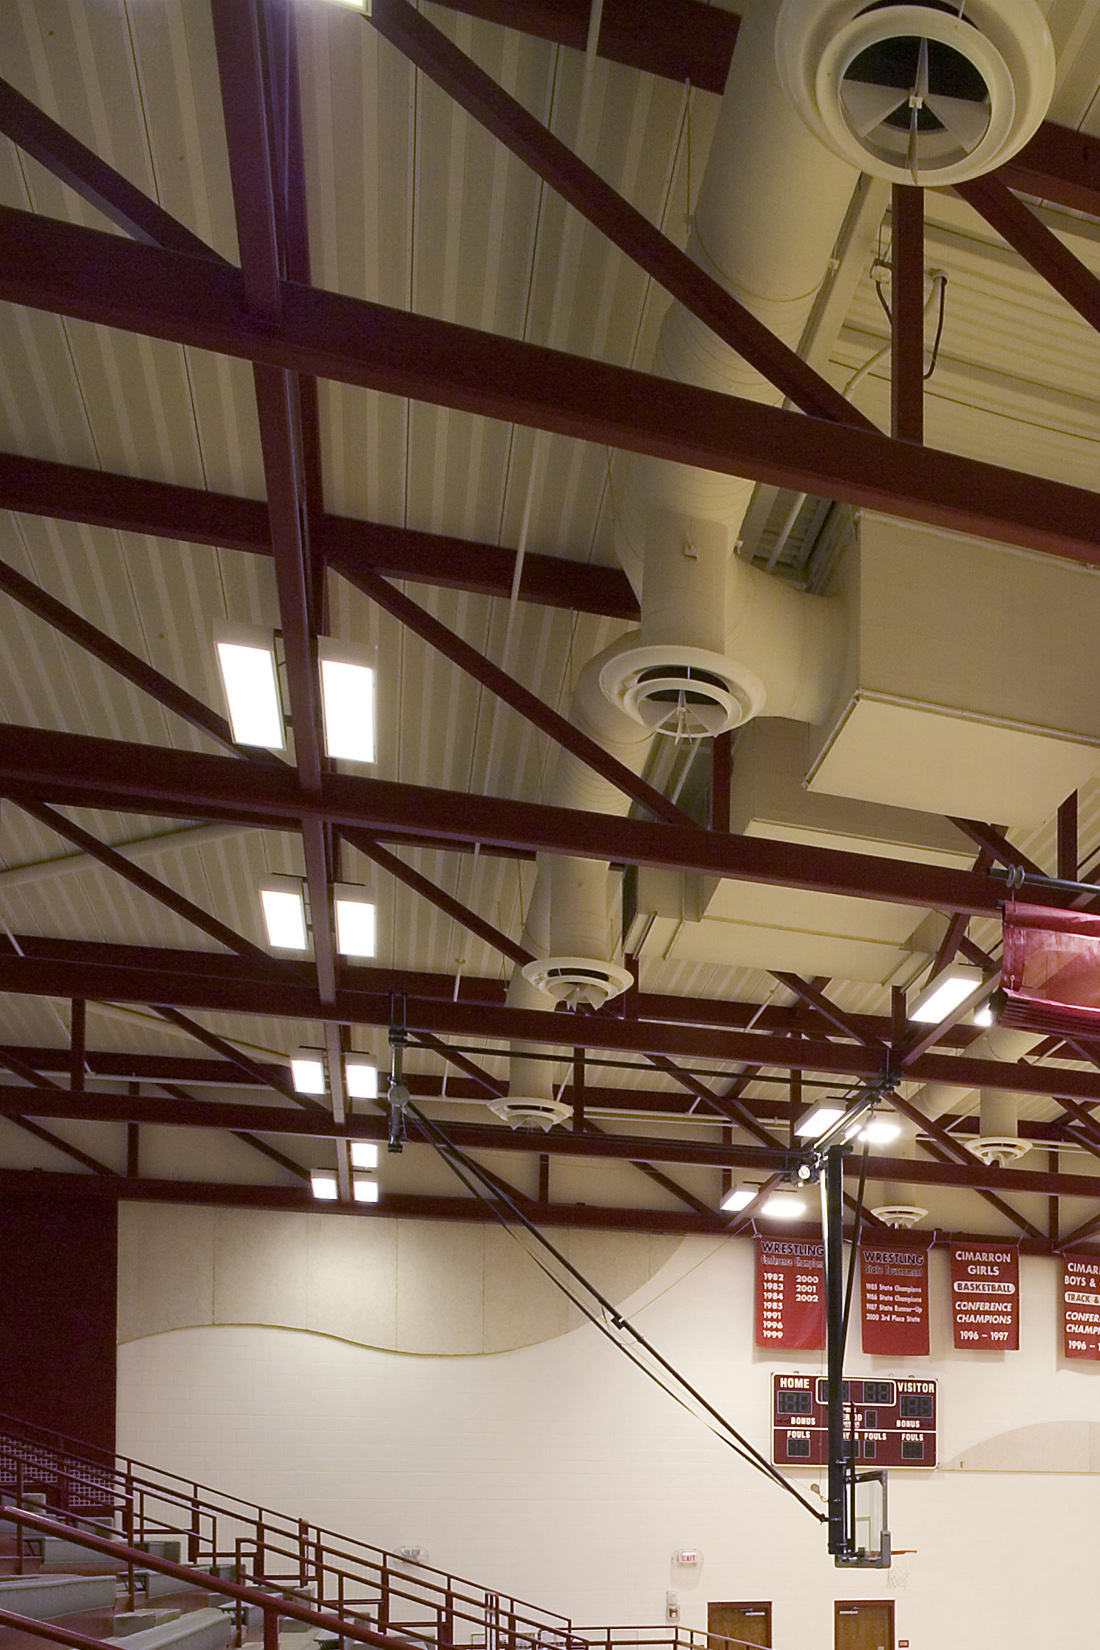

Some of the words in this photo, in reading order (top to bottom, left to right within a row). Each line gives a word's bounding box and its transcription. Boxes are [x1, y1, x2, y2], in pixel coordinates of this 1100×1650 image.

[761, 1241, 825, 1257] WRESTLING
[863, 1250, 924, 1266] WRESTLING
[955, 1251, 1011, 1263] CIMARRON
[967, 1265, 1000, 1276] GIRLS
[763, 1273, 784, 1281] 1982
[795, 1275, 819, 1283] 2000
[1064, 1275, 1086, 1286] BOYS
[1089, 1278, 1096, 1288] &
[763, 1282, 784, 1291] 1983
[795, 1284, 817, 1293] 2001
[957, 1282, 1012, 1293] BASKETBALL
[763, 1292, 784, 1300] 1984
[795, 1294, 819, 1302] 2002
[1067, 1293, 1090, 1303] TRACK
[1093, 1296, 1099, 1304] &
[763, 1301, 783, 1310] 1985
[955, 1301, 1012, 1312] CONFERENCE
[763, 1311, 781, 1319] 1991
[956, 1314, 1012, 1324] CHAMPIONS
[763, 1321, 783, 1329] 1996
[763, 1330, 783, 1339] 1999
[960, 1331, 979, 1340] 1996
[990, 1331, 1009, 1341] 1997
[1068, 1340, 1087, 1350] 1996
[780, 1378, 810, 1389] HOME
[897, 1382, 935, 1393] VISITOR
[791, 1417, 816, 1425] BONUS
[896, 1420, 921, 1428] BONUS
[864, 1432, 887, 1441] FOULS
[902, 1433, 924, 1441] FOULS
